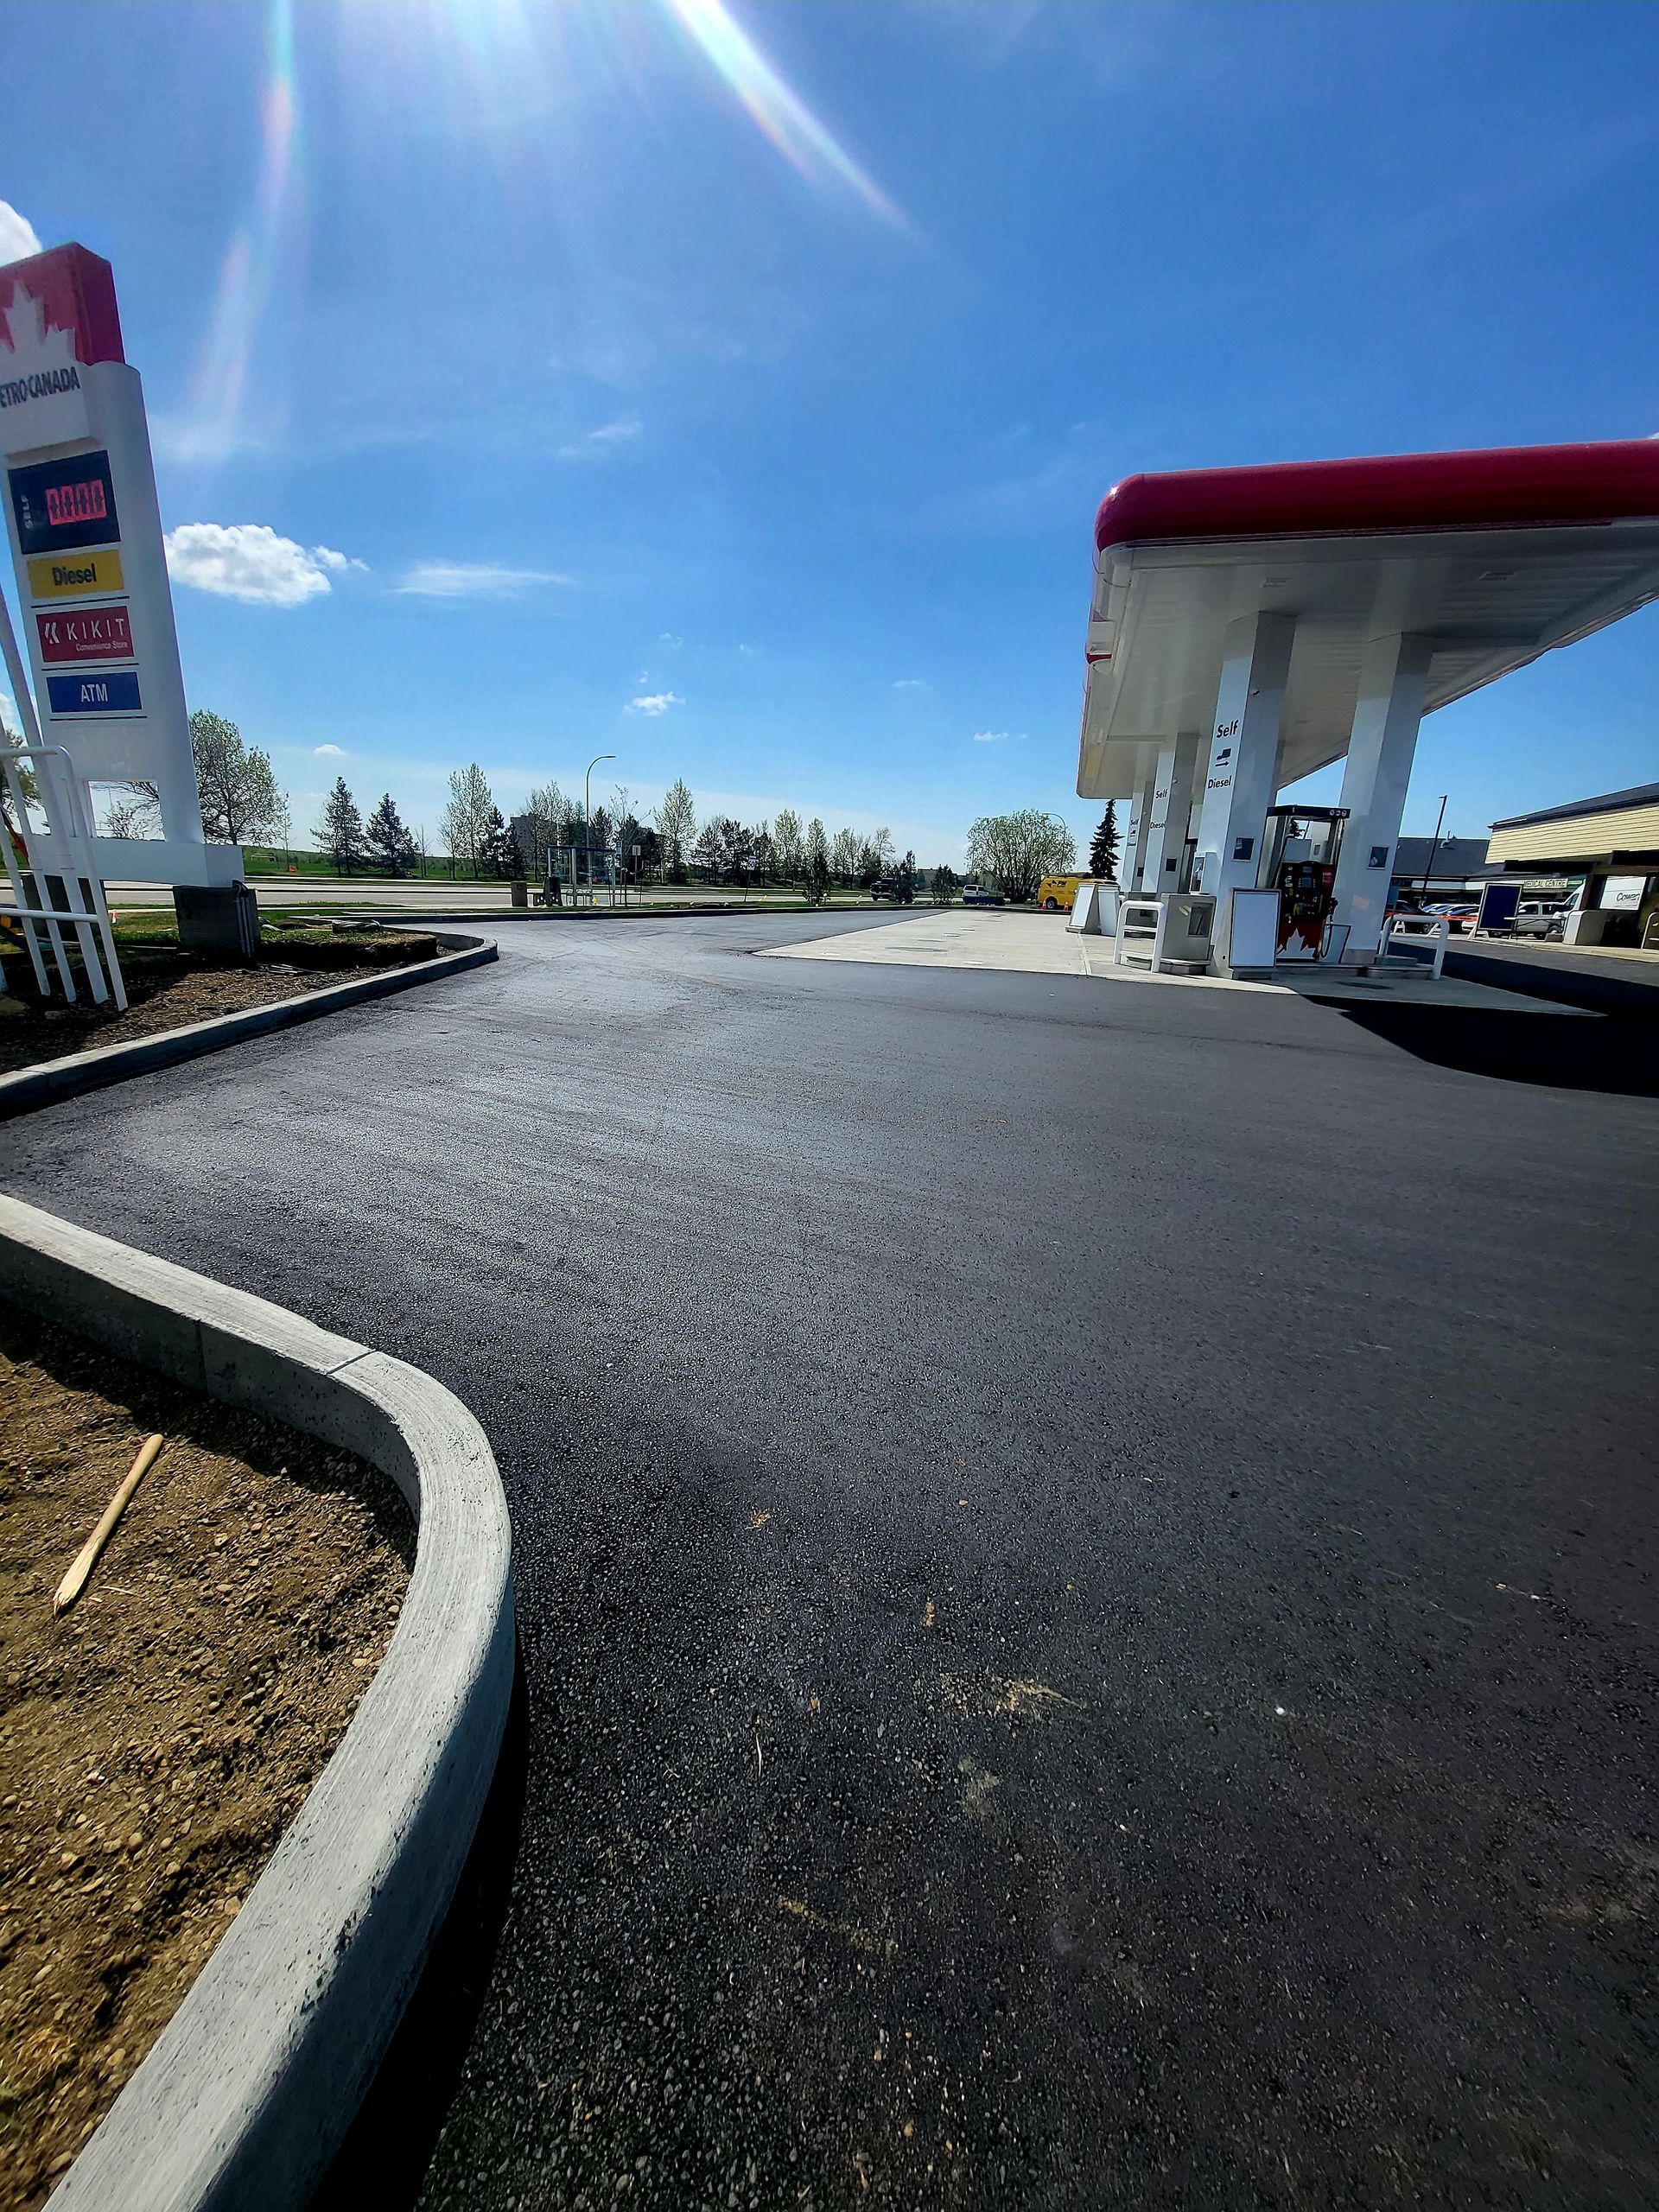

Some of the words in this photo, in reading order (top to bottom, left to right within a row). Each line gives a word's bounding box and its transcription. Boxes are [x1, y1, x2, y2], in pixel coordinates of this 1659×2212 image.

[52, 563, 97, 587] Diesel
[67, 618, 124, 641] KIKIT
[76, 643, 111, 652] Convenience
[112, 640, 128, 649] Store
[80, 683, 108, 702] ATM
[1217, 719, 1238, 738] Self
[1208, 775, 1232, 789] Diesel
[1155, 789, 1168, 798] Self
[1150, 820, 1166, 830] Diesel
